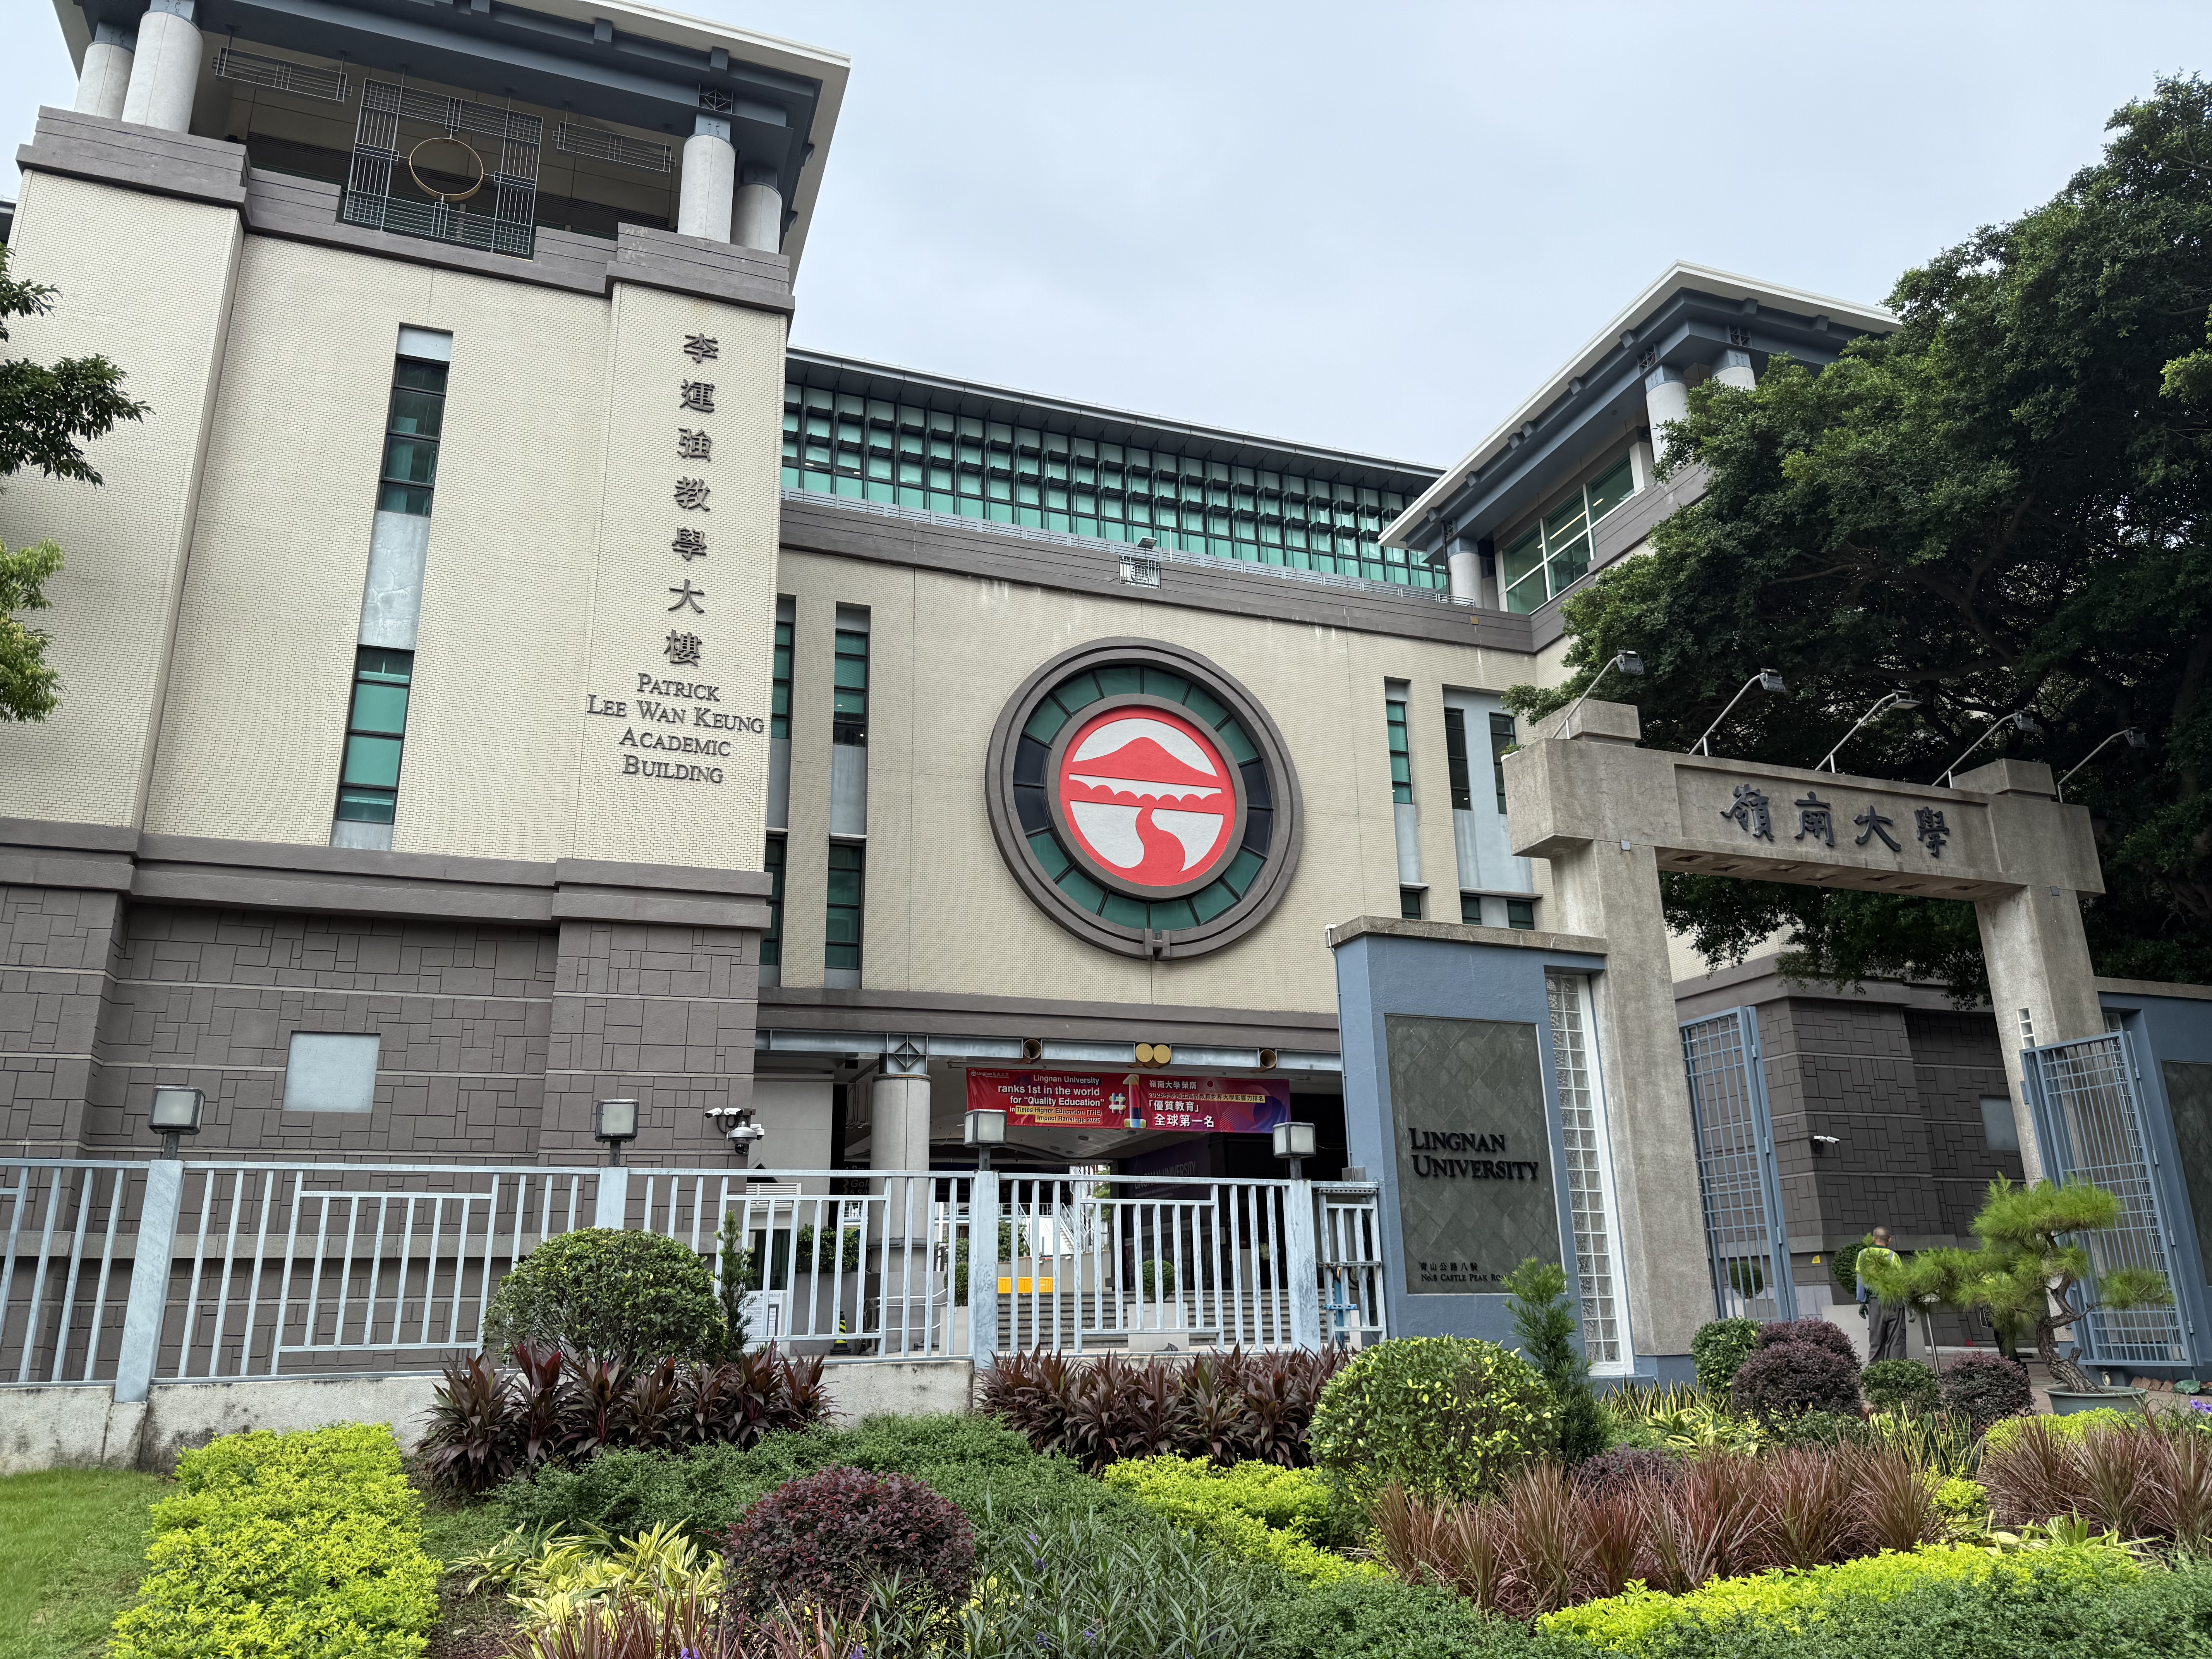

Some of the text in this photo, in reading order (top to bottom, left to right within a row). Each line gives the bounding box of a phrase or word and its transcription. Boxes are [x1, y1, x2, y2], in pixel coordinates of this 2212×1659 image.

[664, 333, 719, 666] 李運強教學大樓
[1720, 783, 1950, 857] 嶺南大學
[1033, 1074, 1099, 1084] Lingnan University
[998, 1084, 1100, 1096] ranks 1st in the world
[1010, 1096, 1022, 1104] for
[1058, 1115, 1085, 1123] Rankings
[1154, 1113, 1215, 1128] 全球第一名
[850, 1178, 870, 1188] Gol
